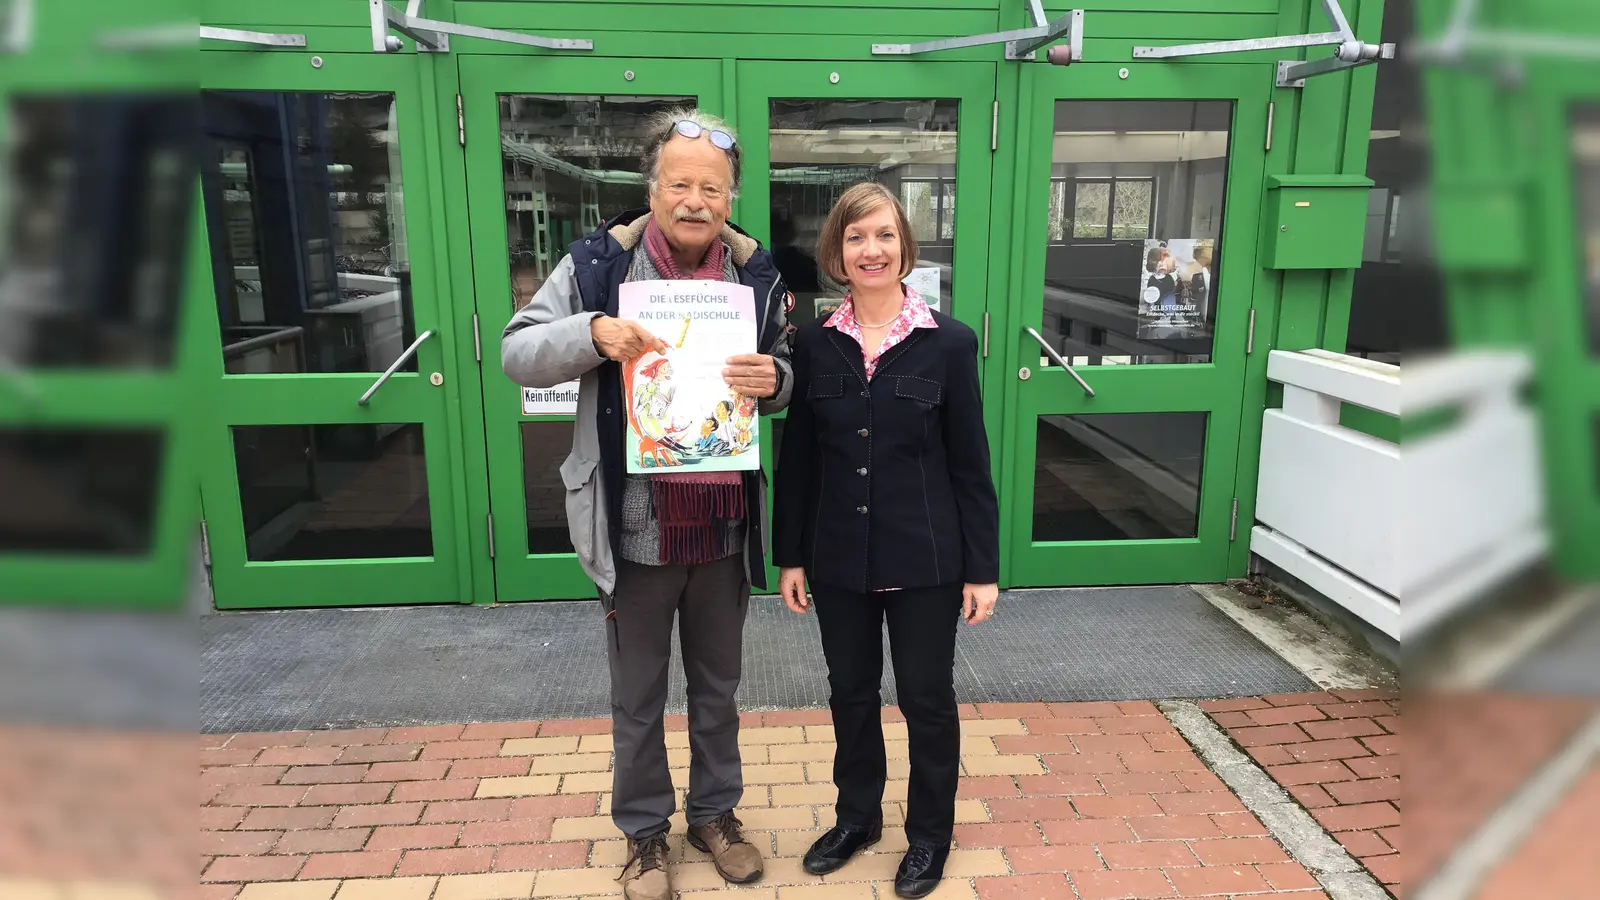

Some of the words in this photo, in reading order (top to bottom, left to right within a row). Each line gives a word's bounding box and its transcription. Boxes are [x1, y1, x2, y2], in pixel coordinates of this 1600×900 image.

[649, 295, 666, 303] DIE
[638, 311, 653, 320] AN
[656, 311, 676, 320] DER
[525, 390, 543, 402] Kein
